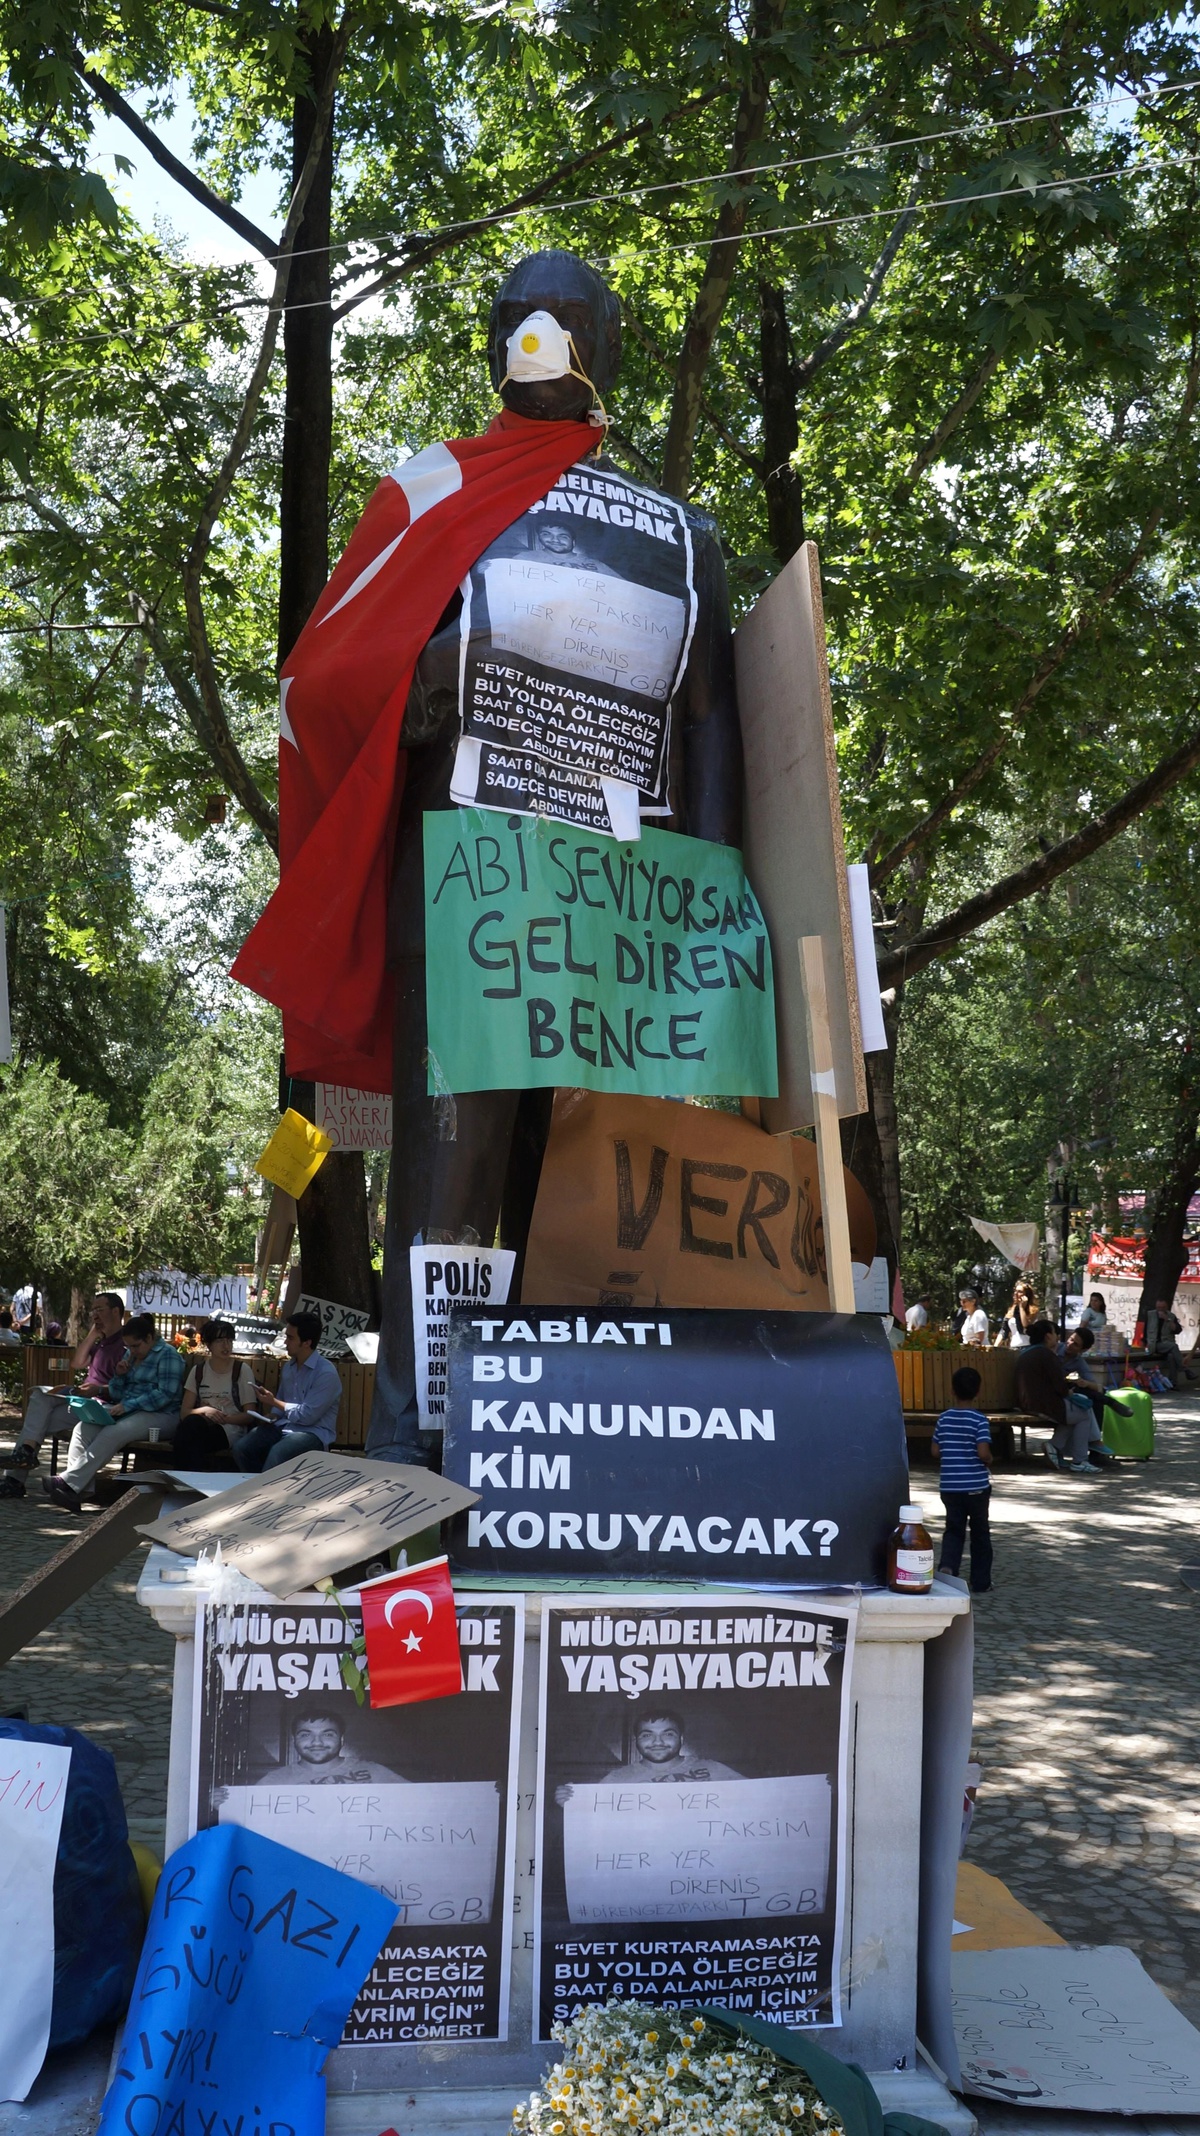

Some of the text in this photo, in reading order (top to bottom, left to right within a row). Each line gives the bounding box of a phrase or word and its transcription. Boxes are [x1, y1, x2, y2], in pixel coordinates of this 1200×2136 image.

[474, 677, 658, 747] BU YOLDA ÖLECEĞİZ
[526, 674, 661, 729] KURTARAMASAKTA
[472, 694, 656, 760] SAAT 6 DA ALANLARDAYIM
[472, 708, 543, 740] SADECE
[545, 728, 615, 762] DEVRİM
[487, 753, 523, 771] SAAT
[524, 759, 533, 772] 6
[534, 763, 548, 779] DA
[522, 738, 652, 789] ABDULLAH CÖMERT
[485, 771, 605, 812] SADECE DEVRİM
[529, 798, 592, 824] ABDULLAH
[432, 815, 764, 937] ABİ SEVİYORSAN
[467, 910, 767, 1000] GEL DİREN
[526, 996, 708, 1072] BENCE
[322, 1106, 389, 1127] ASKERİ
[424, 1257, 492, 1298] POLİS
[338, 1309, 368, 1332] YOK
[471, 1316, 673, 1346] TABİATI
[472, 1355, 543, 1384] BU
[470, 1399, 777, 1441] KANUNDAN
[469, 1445, 571, 1490] KİM
[466, 1510, 841, 1557] KORUYACAK?
[560, 1614, 834, 1646] MÜCADELEMİZDE
[560, 1651, 832, 1700] YAŞAYACAK
[249, 1794, 382, 1815] HER YER
[593, 1792, 721, 1813] HER YER
[358, 1823, 477, 1846] TAKSİM
[697, 1817, 811, 1838] TAKSİM
[595, 1849, 716, 1871] HER YER
[624, 1934, 822, 1956] KURTARAMASAKTA
[554, 1951, 818, 1980] BU YOLDA ÖLECEĞİZ
[553, 1970, 818, 1998] SAAT 6 DA ALANLARDAYIM
[399, 2023, 486, 2040] CÖMERT
[746, 2008, 820, 2025] ÖMERT
